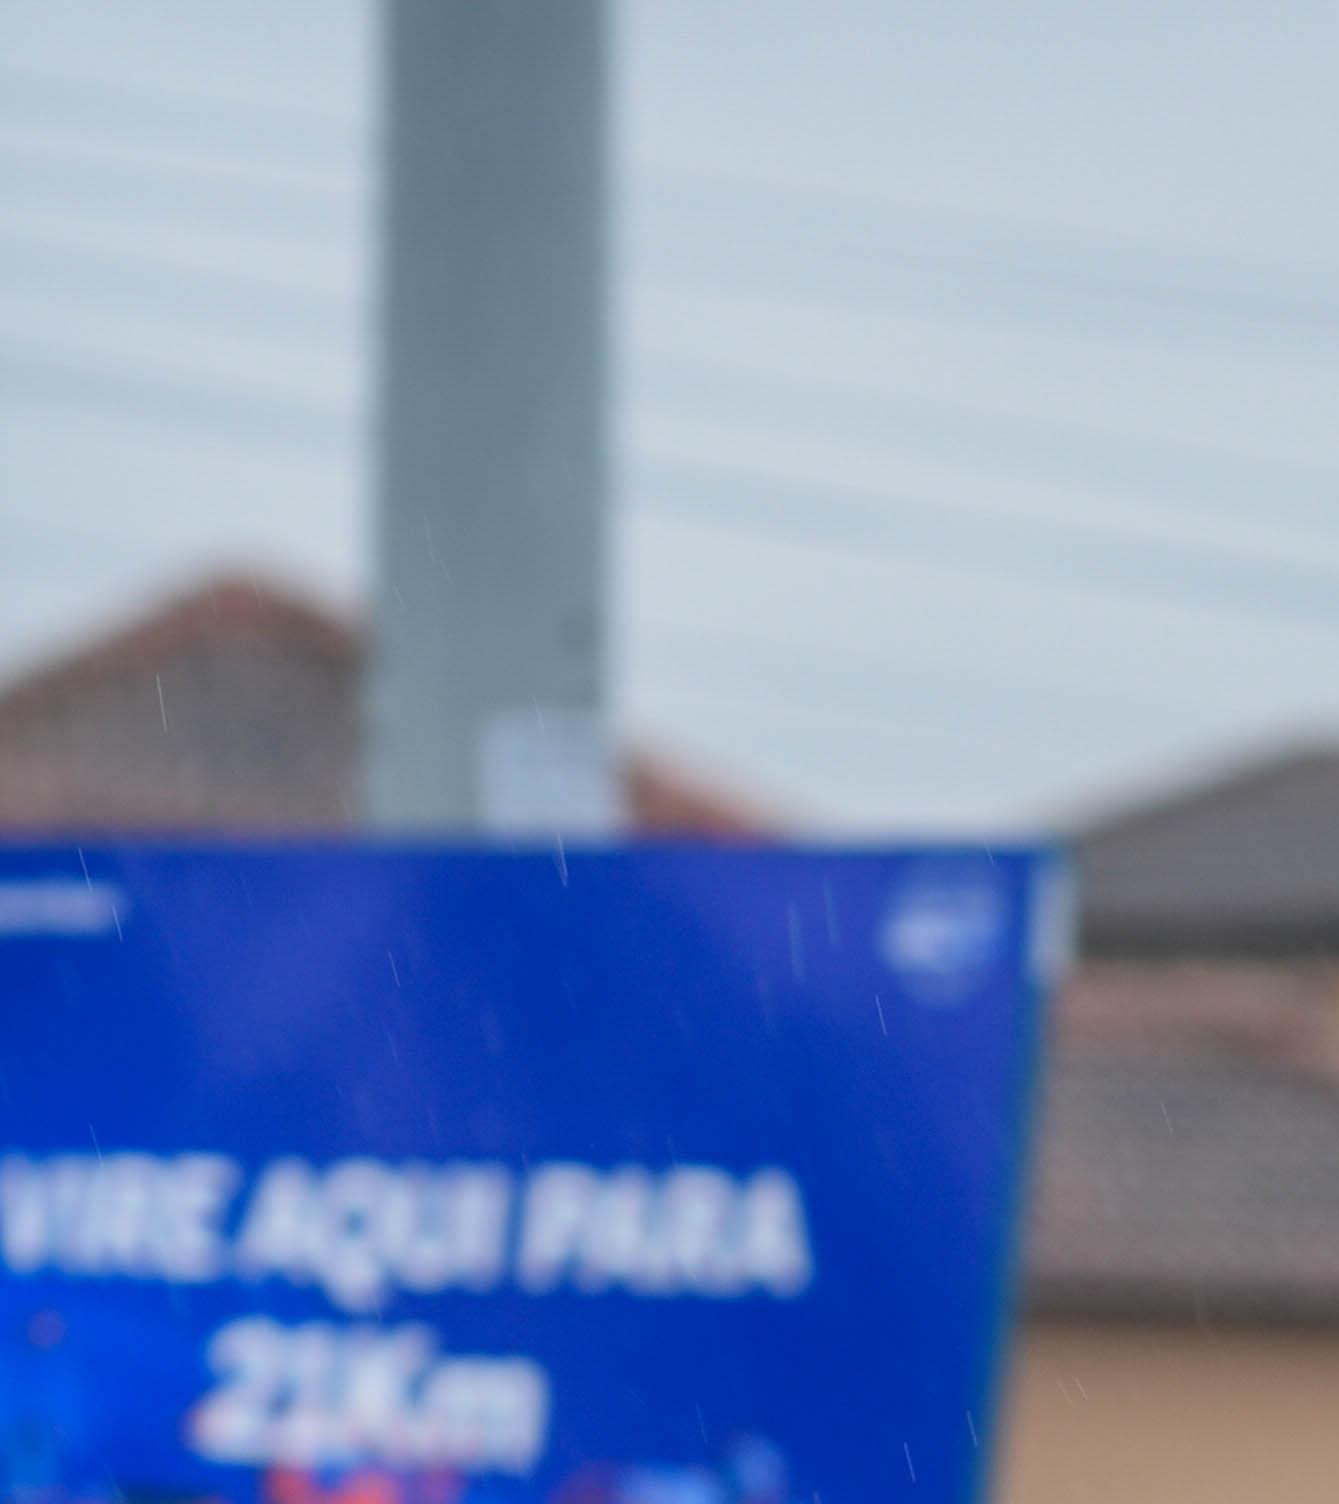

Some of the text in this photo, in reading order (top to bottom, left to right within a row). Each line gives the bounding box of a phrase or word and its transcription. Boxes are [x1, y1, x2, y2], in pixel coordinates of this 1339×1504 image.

[0, 1152, 813, 1312] VIRE AQUI PARA
